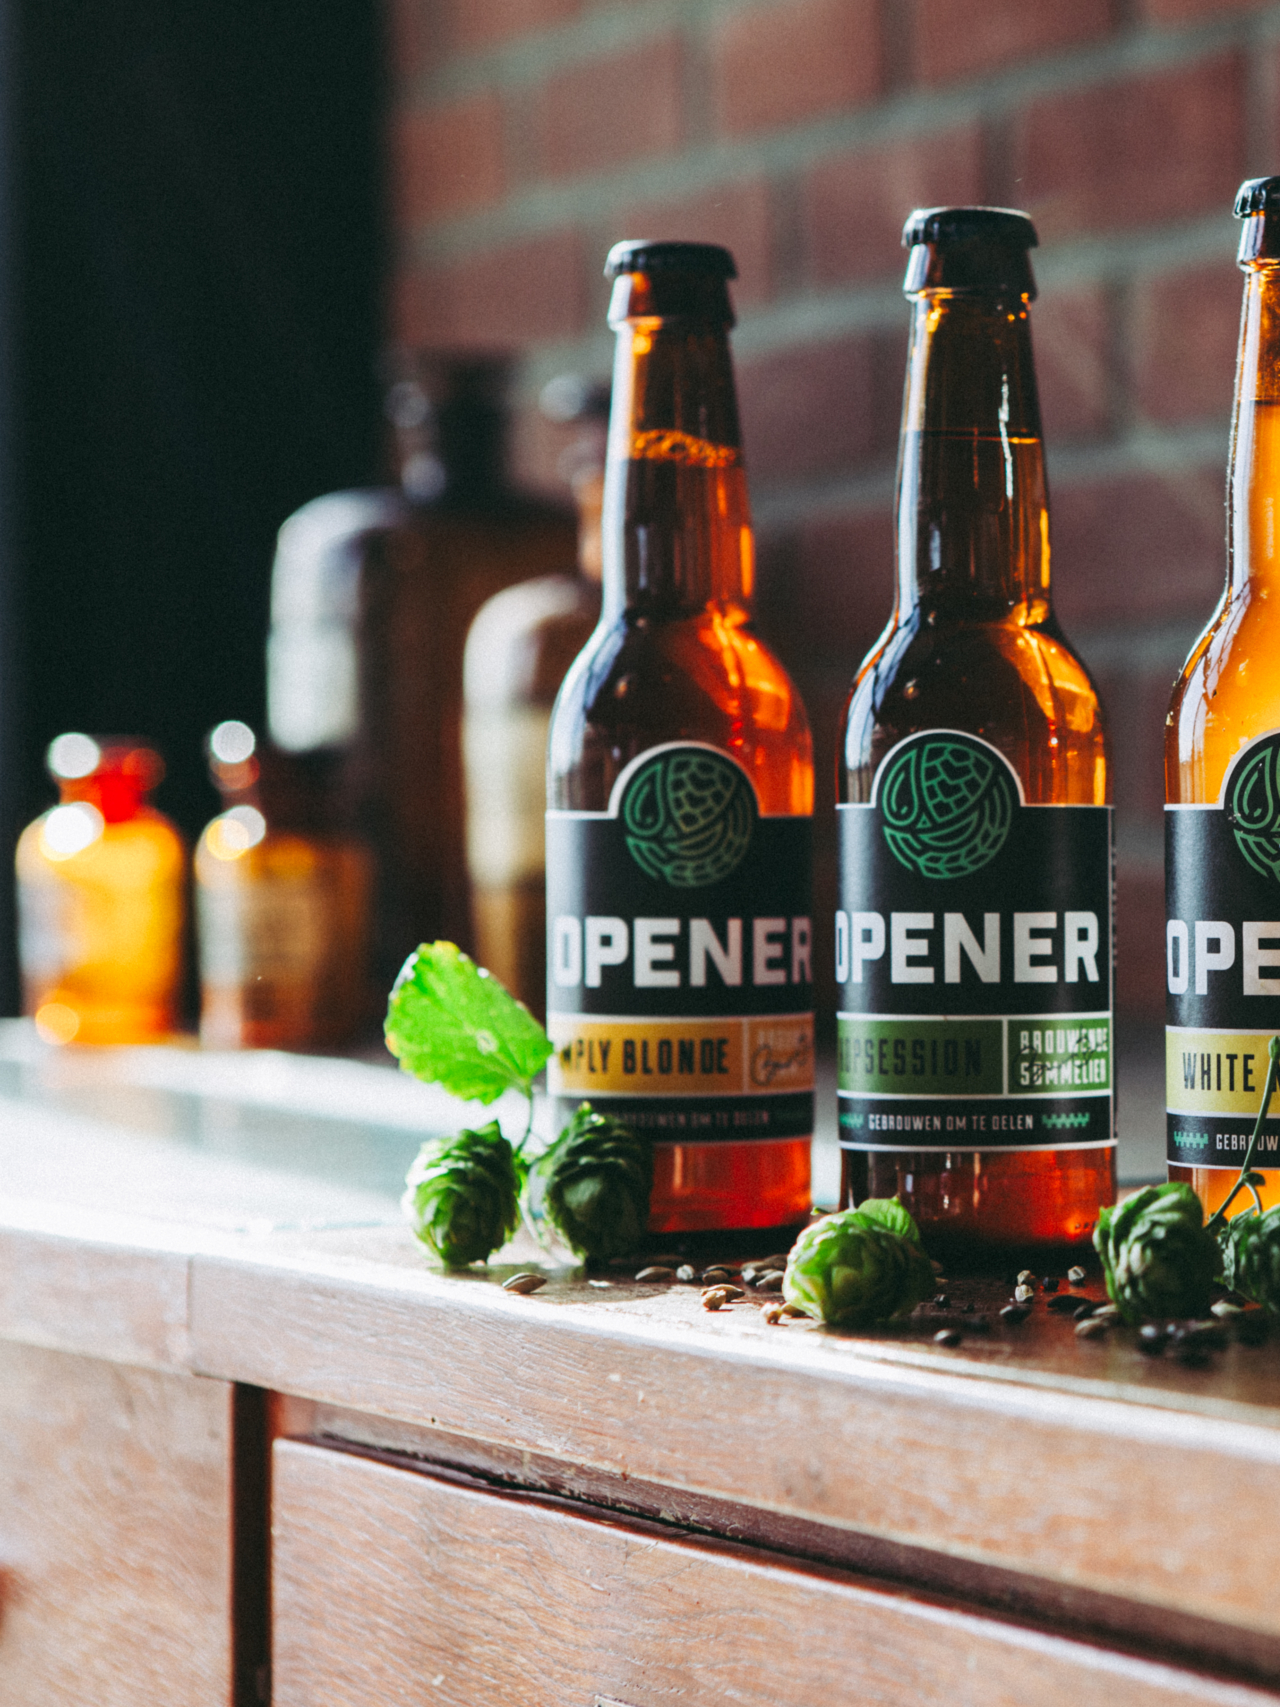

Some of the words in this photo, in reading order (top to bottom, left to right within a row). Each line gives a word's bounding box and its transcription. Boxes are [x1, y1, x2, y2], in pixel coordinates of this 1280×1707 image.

[552, 915, 813, 988] OPENER
[836, 909, 1100, 984] OPENER
[622, 1038, 729, 1075] BLONDE
[1182, 1052, 1256, 1092] WHITE
[868, 1113, 941, 1131] GEBROUWEN
[946, 1114, 966, 1131] OM
[972, 1114, 986, 1131] TE
[992, 1114, 1033, 1131] DELEN
